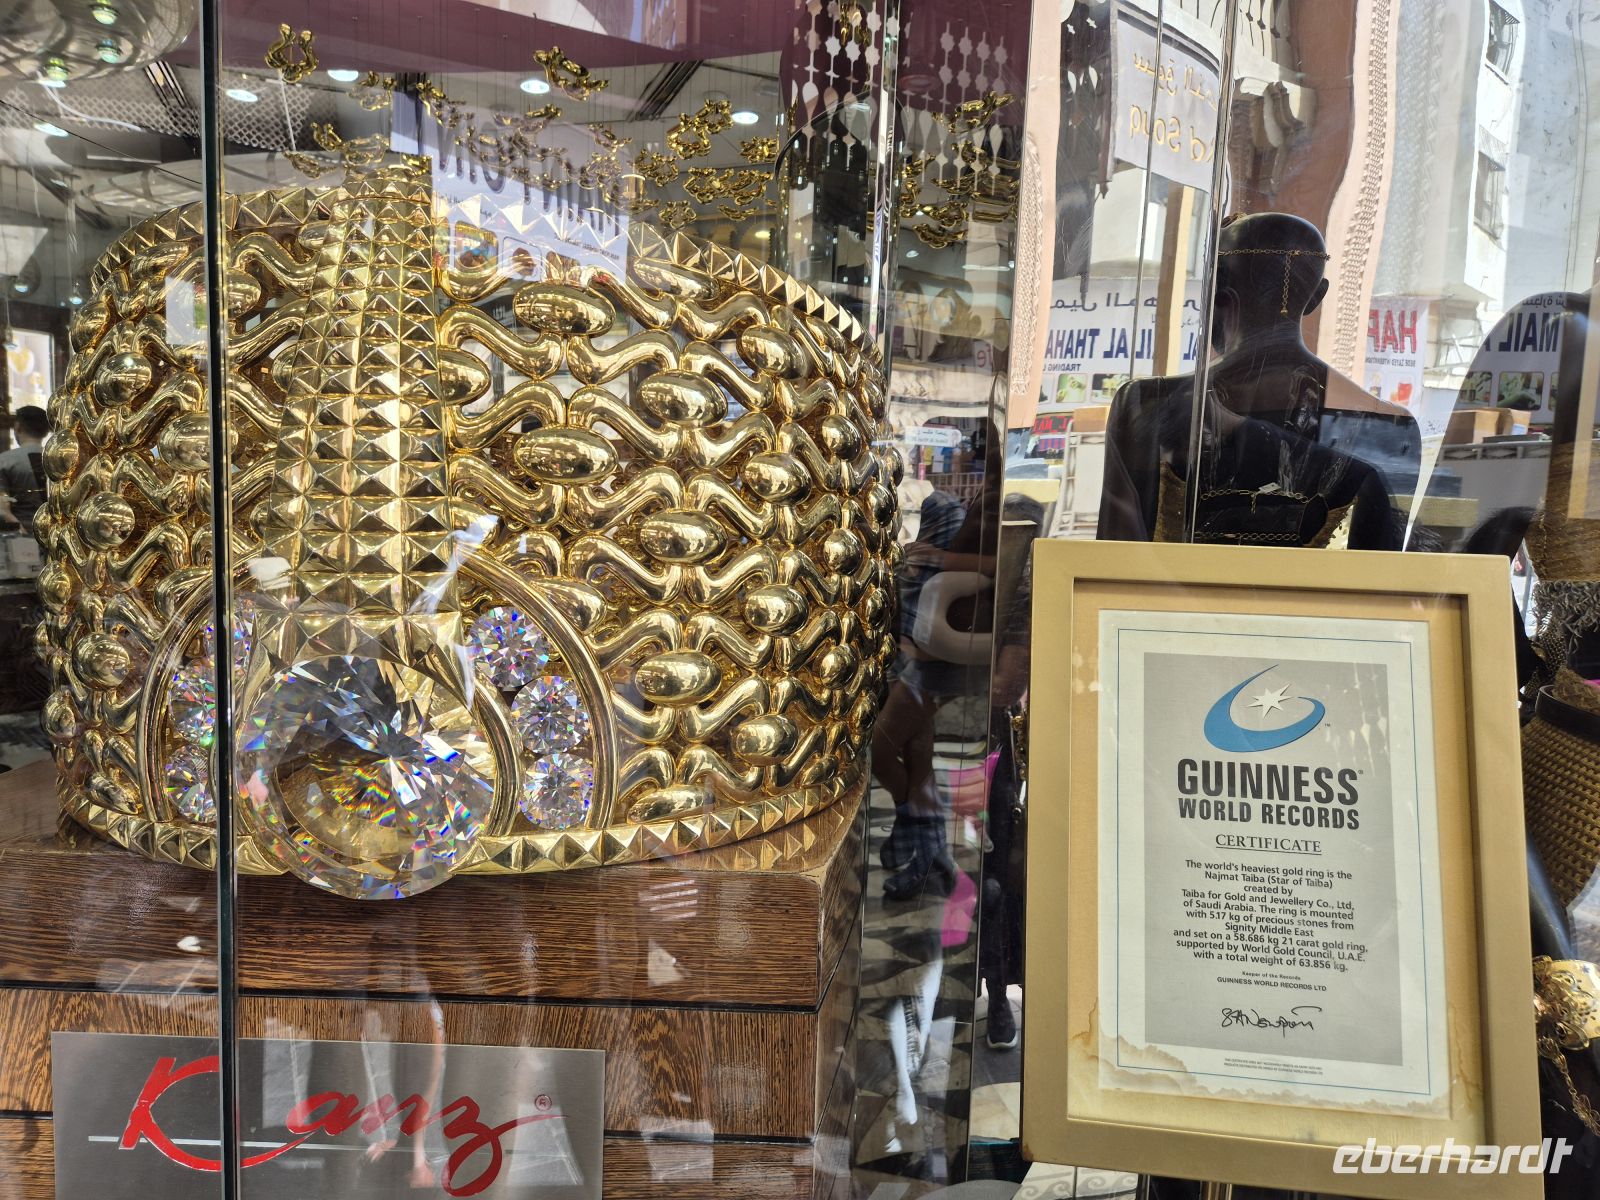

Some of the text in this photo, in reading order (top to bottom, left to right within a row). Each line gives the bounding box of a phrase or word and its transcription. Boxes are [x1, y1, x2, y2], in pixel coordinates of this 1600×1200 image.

[1178, 759, 1358, 805] GUINNESS
[1178, 797, 1360, 830] WORLD RECORDS
[1215, 834, 1321, 853] CERTIFICATE
[1186, 860, 1352, 879] The world's heaviest gold ring is the
[1205, 871, 1238, 882] Najmat
[1242, 874, 1265, 883] Taiba
[1267, 875, 1289, 885] (Star
[1306, 879, 1333, 889] Taiba)
[1182, 889, 1205, 898] Taiba
[1208, 891, 1221, 899] for
[1225, 892, 1245, 901] Gold
[1249, 894, 1266, 902] and
[1270, 896, 1313, 908] Jewellery
[1244, 884, 1293, 896] created by
[1184, 900, 1353, 920] of Saudi Arabia. The ring is mounted
[1186, 910, 1354, 930] with 5.17 kg of precious stones from
[1225, 922, 1314, 937] Signity Middle East
[1174, 929, 1191, 937] and
[1194, 930, 1207, 938] set
[1234, 932, 1264, 943] 58.686
[1267, 935, 1279, 945] kg
[1282, 937, 1293, 945] 21
[1296, 939, 1319, 947] carat
[1322, 941, 1343, 951] gold
[1347, 943, 1368, 953] ring,
[1177, 939, 1224, 950] supported
[1227, 942, 1238, 953] by
[1242, 944, 1270, 953] World
[1273, 946, 1294, 955] Gold
[1338, 952, 1365, 962] U.A.E.
[1194, 951, 1214, 959] with
[1225, 954, 1248, 962] total
[1251, 956, 1283, 967] weight
[1286, 958, 1296, 966] of
[1299, 959, 1330, 969] 63.856
[1217, 977, 1252, 985] GUINNESS
[1280, 982, 1312, 990] RECORDS
[118, 1054, 571, 1197] Kanz
